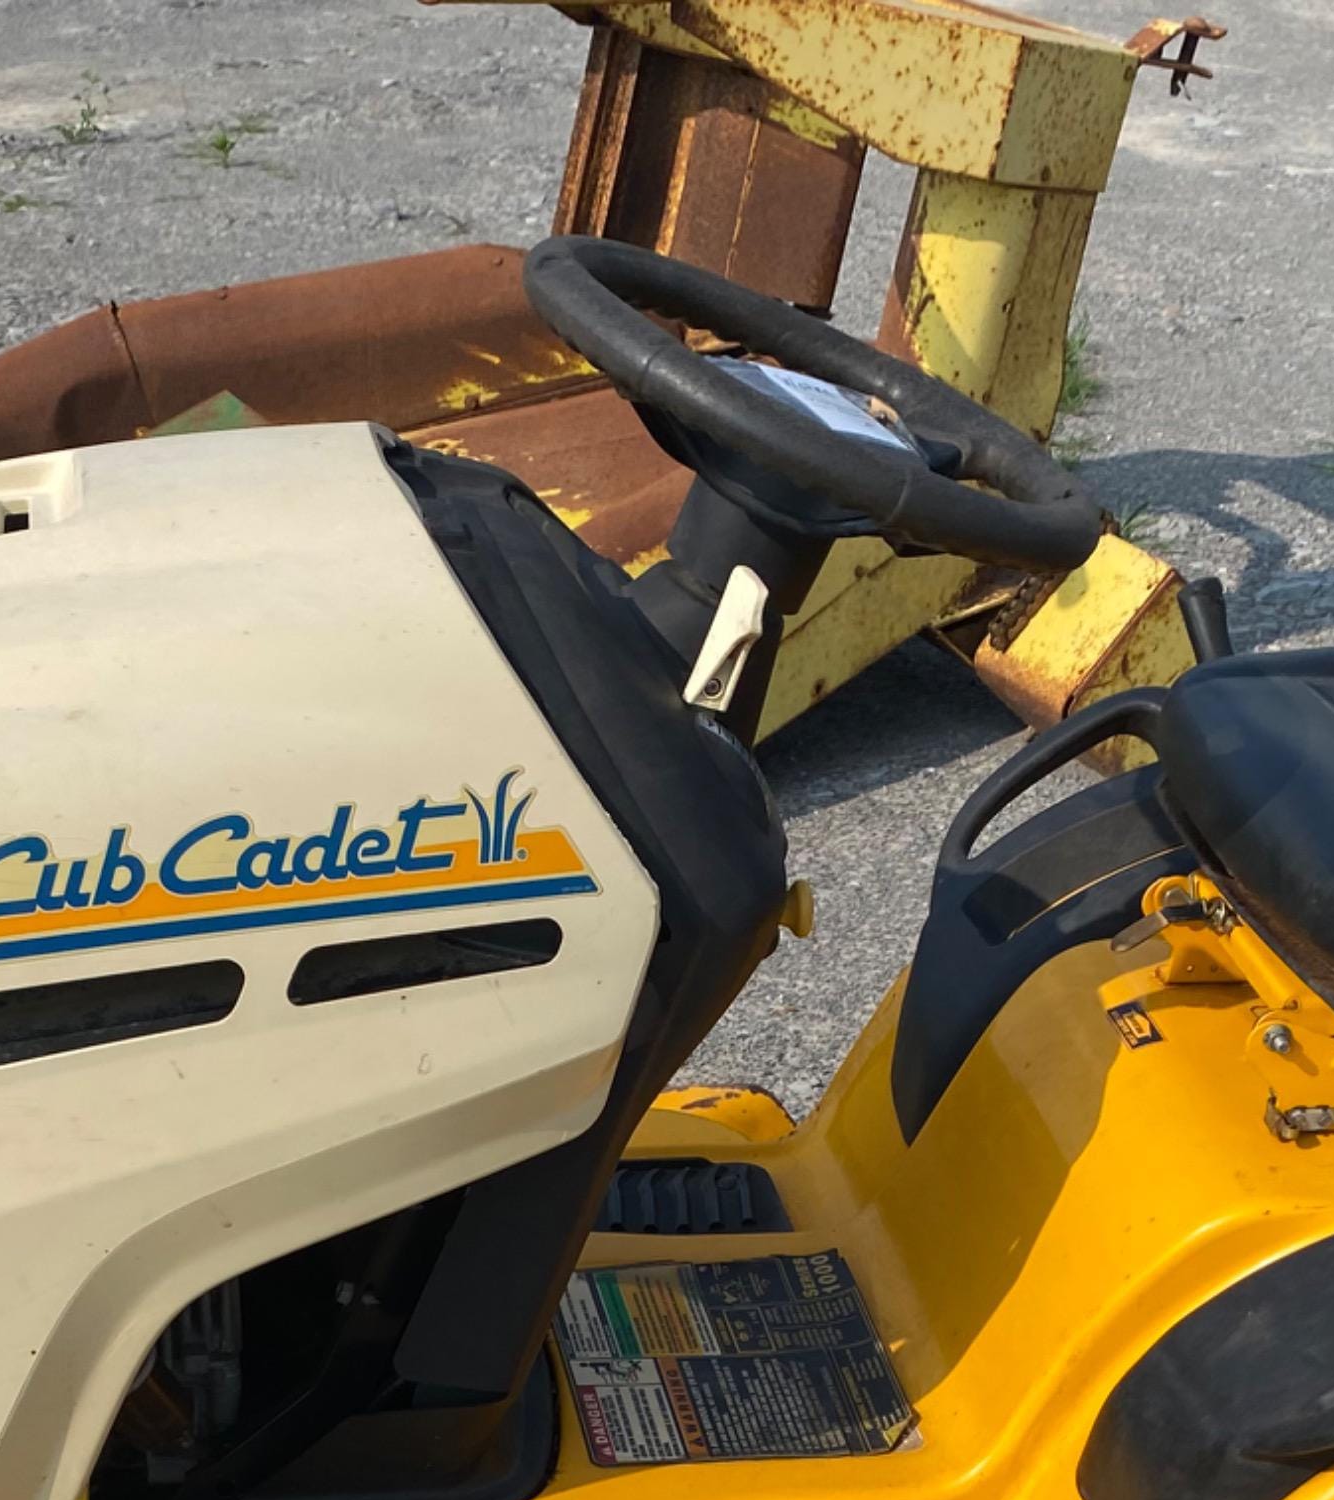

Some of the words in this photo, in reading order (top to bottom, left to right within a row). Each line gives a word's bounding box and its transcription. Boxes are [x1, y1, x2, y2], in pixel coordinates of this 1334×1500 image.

[159, 799, 467, 896] Cadet
[810, 1254, 842, 1294] 1000
[583, 1393, 609, 1444] DANGER
[666, 1370, 698, 1433] WARNING
